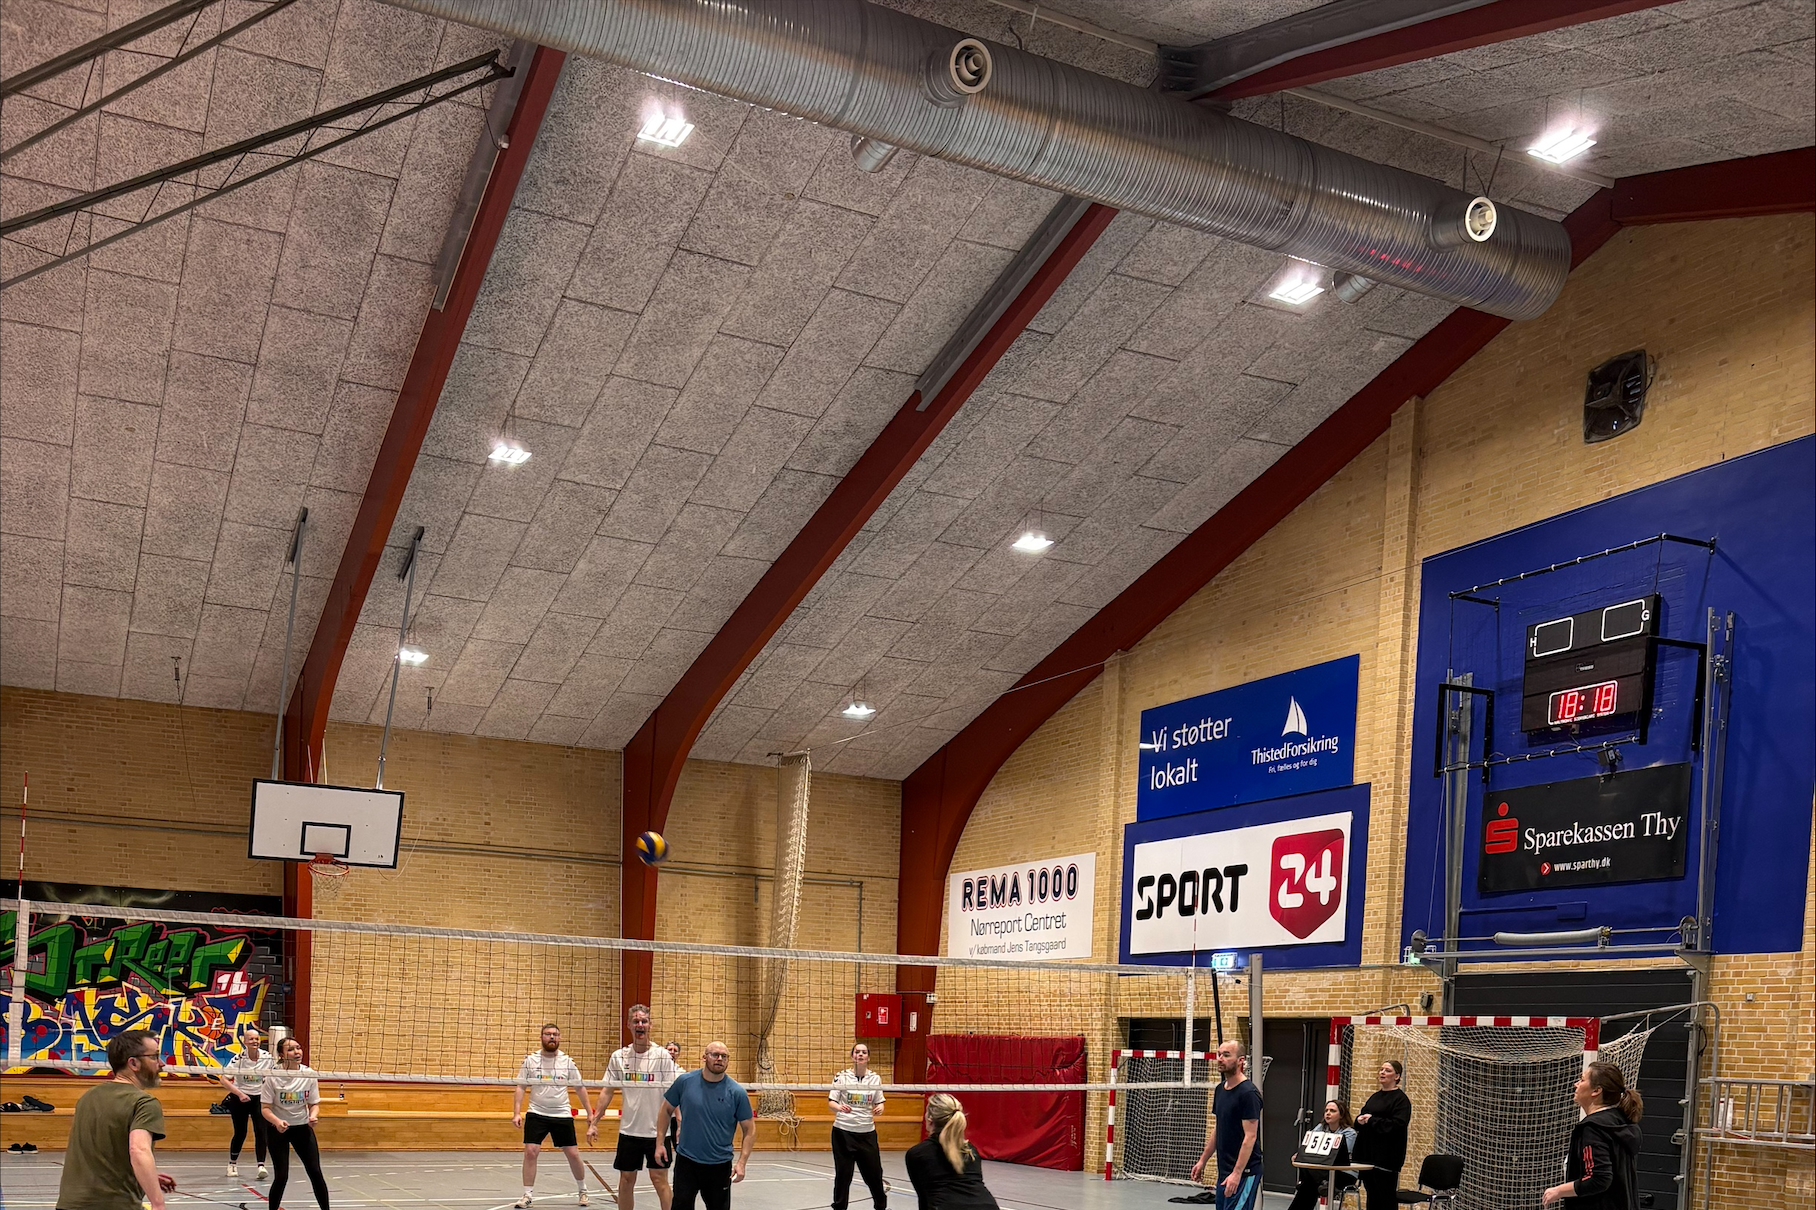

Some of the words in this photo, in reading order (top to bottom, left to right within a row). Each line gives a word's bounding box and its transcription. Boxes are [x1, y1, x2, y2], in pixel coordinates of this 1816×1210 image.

[1641, 610, 1650, 621] G
[1529, 637, 1537, 648] H
[1558, 683, 1615, 719] 18:18
[1152, 726, 1168, 753] Vi
[1172, 716, 1233, 749] støtter
[1251, 735, 1340, 766] ThistedForsikring
[1150, 758, 1199, 791] lokalt
[1523, 820, 1636, 856] Sparekassen
[1640, 811, 1682, 841] Thy
[1553, 857, 1612, 872] www.sparthy.dk
[962, 871, 1022, 912] REMA
[1027, 863, 1080, 905] 1000
[1136, 863, 1249, 920] SPORT
[1277, 848, 1338, 909] 24
[970, 916, 1023, 939] Nørreport
[1024, 911, 1067, 932] Centret
[1007, 941, 1024, 954] Jens
[1025, 937, 1067, 955] Tangsgaard
